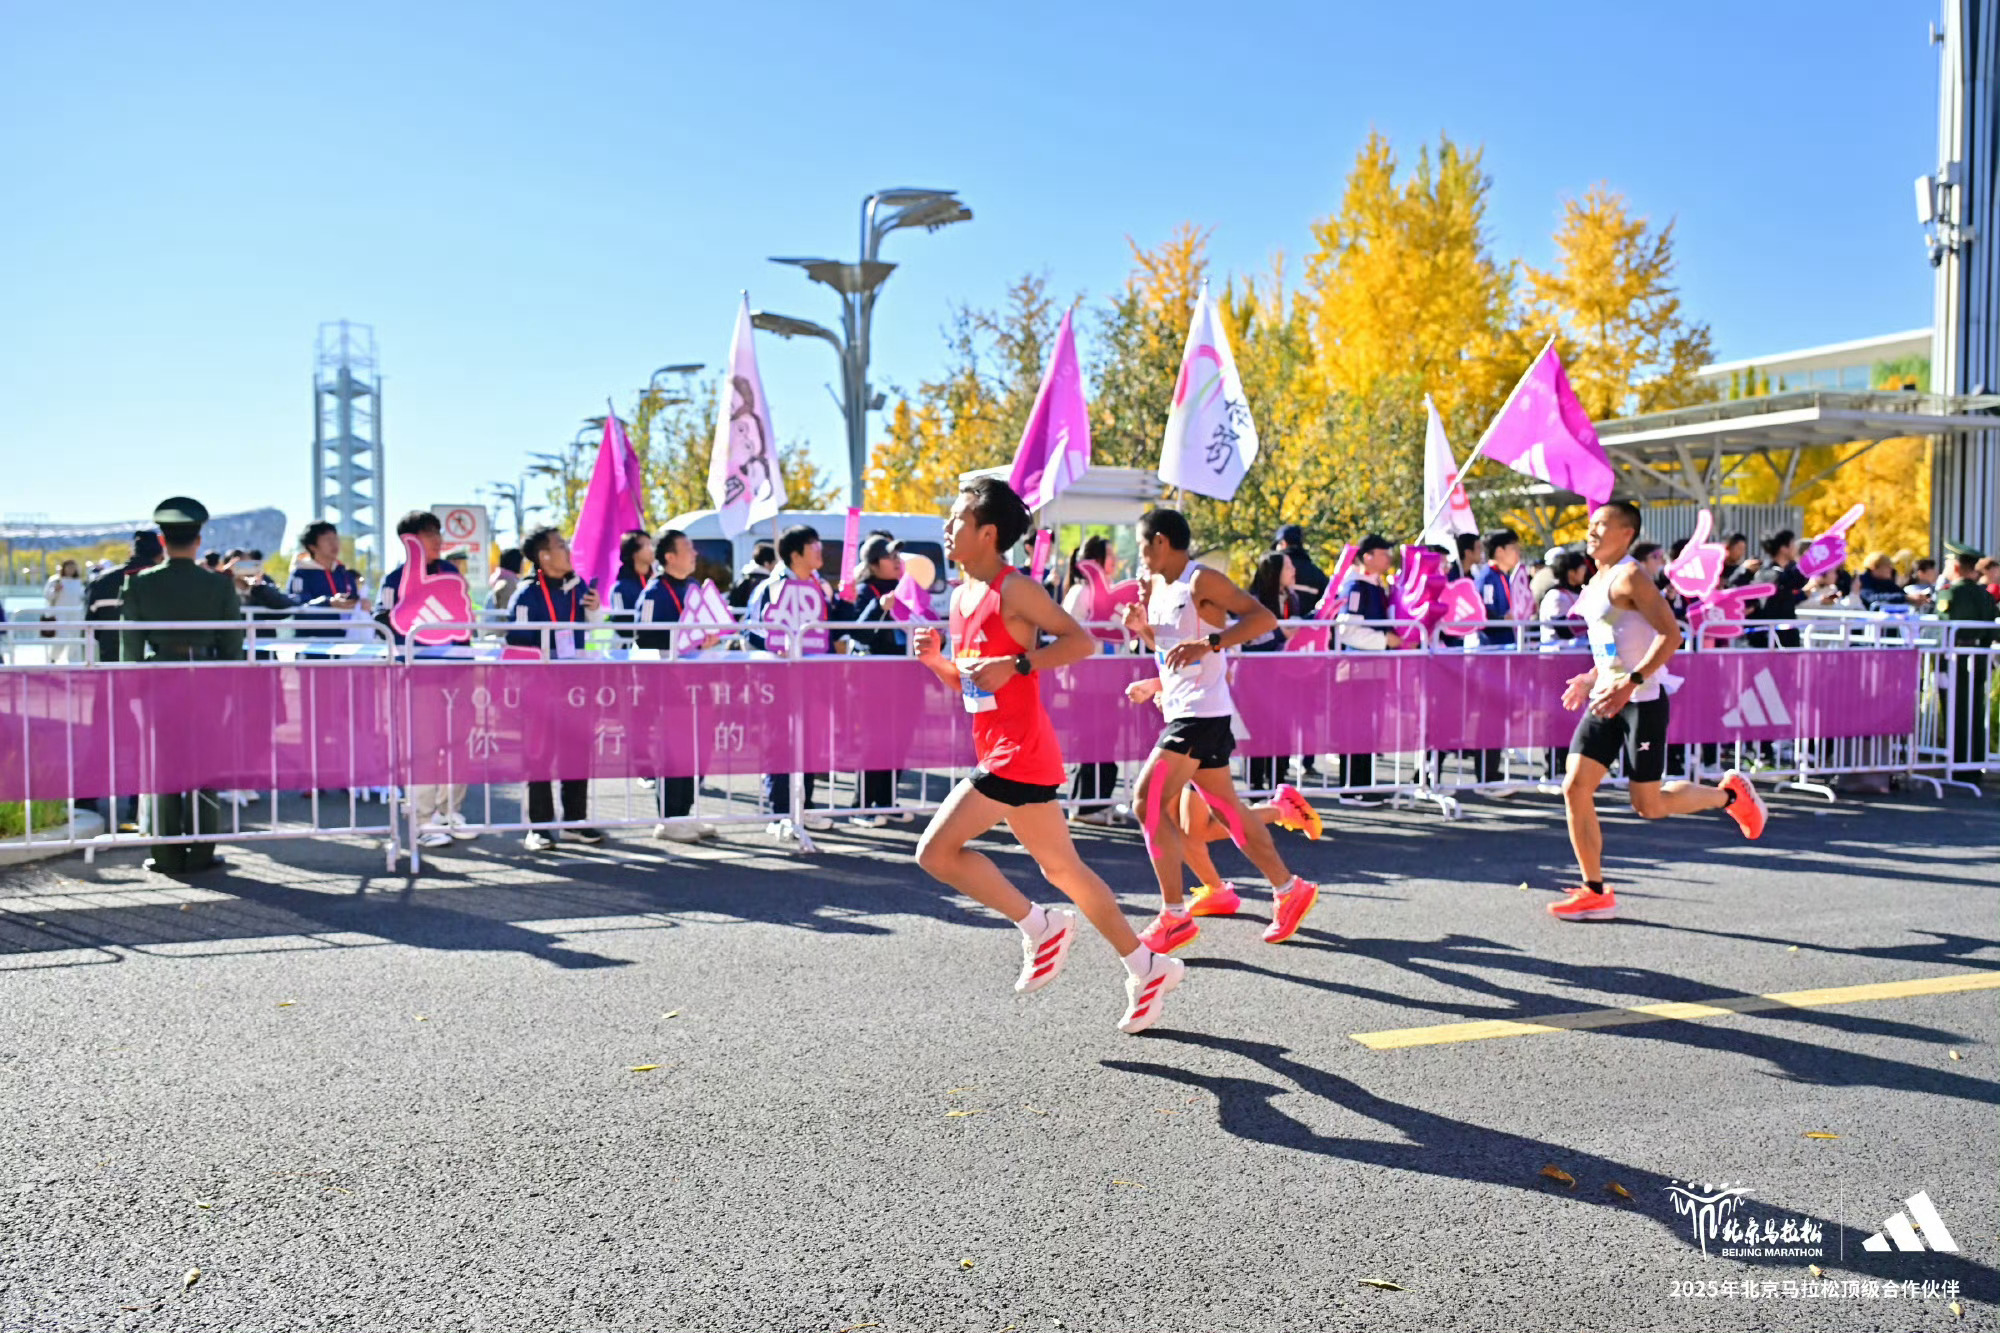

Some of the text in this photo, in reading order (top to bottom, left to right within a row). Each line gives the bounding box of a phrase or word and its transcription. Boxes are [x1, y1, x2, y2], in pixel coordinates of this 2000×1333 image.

[441, 683, 775, 709] YOU GOT THIS
[466, 721, 745, 760] 你 行 的
